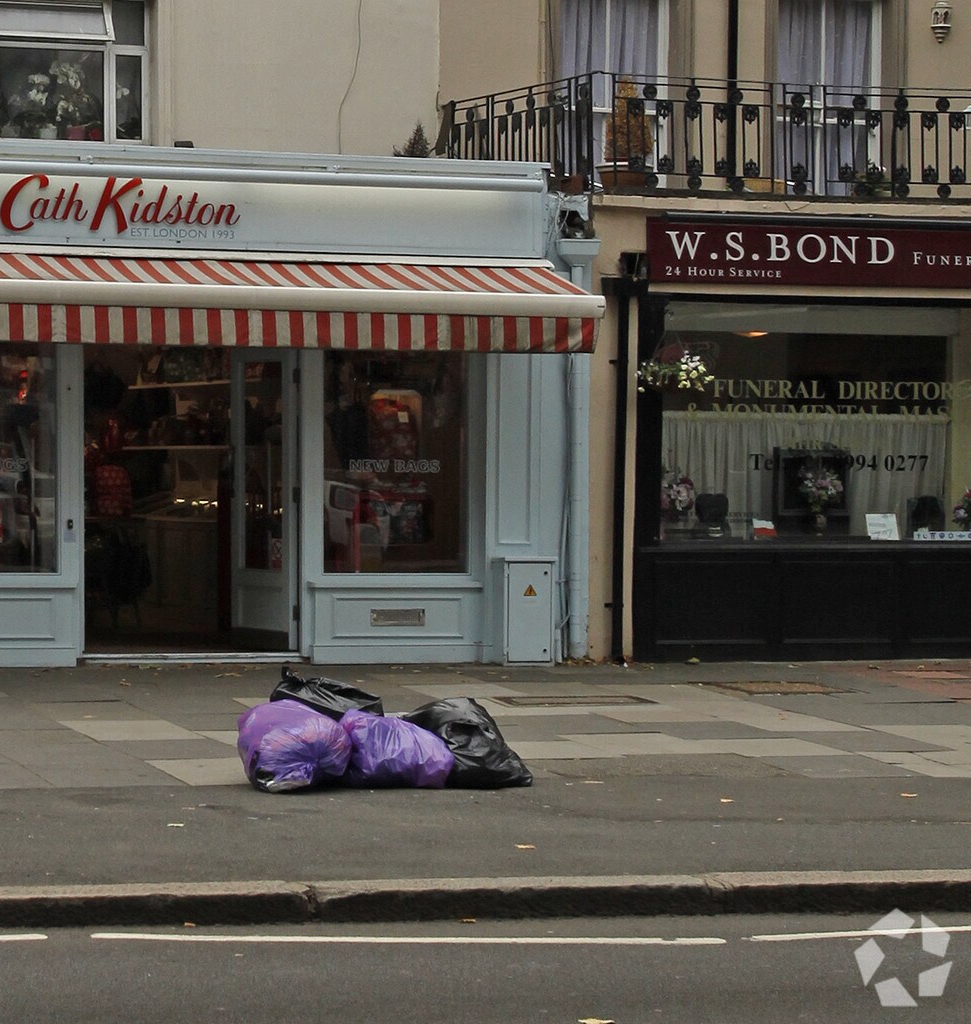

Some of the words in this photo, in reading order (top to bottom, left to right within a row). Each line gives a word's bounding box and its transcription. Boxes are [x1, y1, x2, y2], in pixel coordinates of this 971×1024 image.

[0, 172, 89, 233] Cath
[89, 175, 241, 235] Kidston
[153, 228, 208, 239] LONDON
[211, 229, 236, 240] 1993
[665, 265, 681, 276] 24
[713, 379, 826, 399] FUNERAL
[349, 458, 389, 473] NEW
[394, 459, 441, 474] BAGS
[884, 453, 929, 472] 0277
